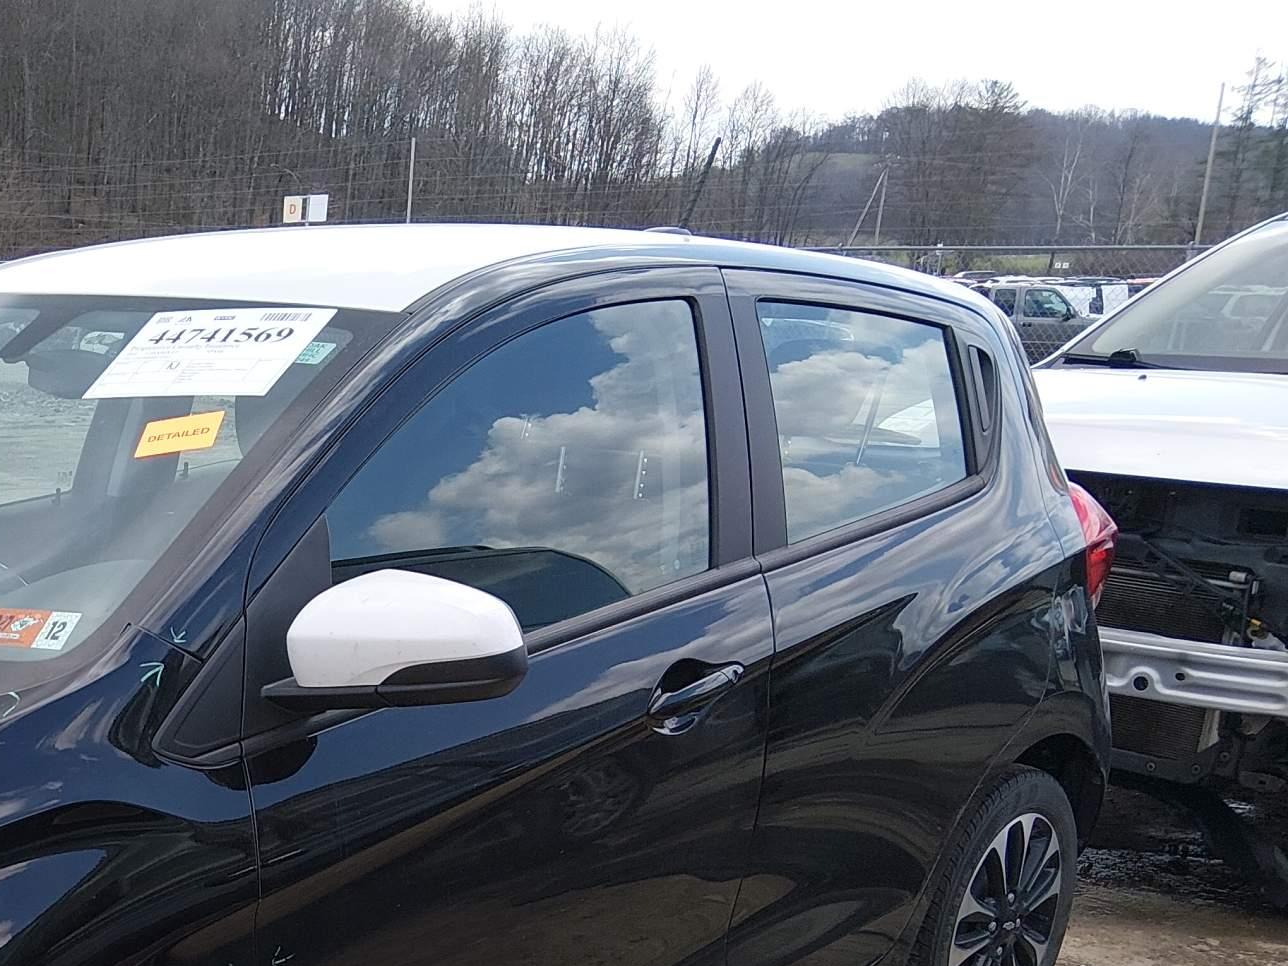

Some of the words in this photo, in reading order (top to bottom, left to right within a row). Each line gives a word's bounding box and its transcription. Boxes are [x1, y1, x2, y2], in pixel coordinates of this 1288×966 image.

[289, 203, 297, 215] D
[148, 326, 295, 345] 44741569
[147, 426, 211, 443] DETAILED
[45, 620, 67, 640] 12
